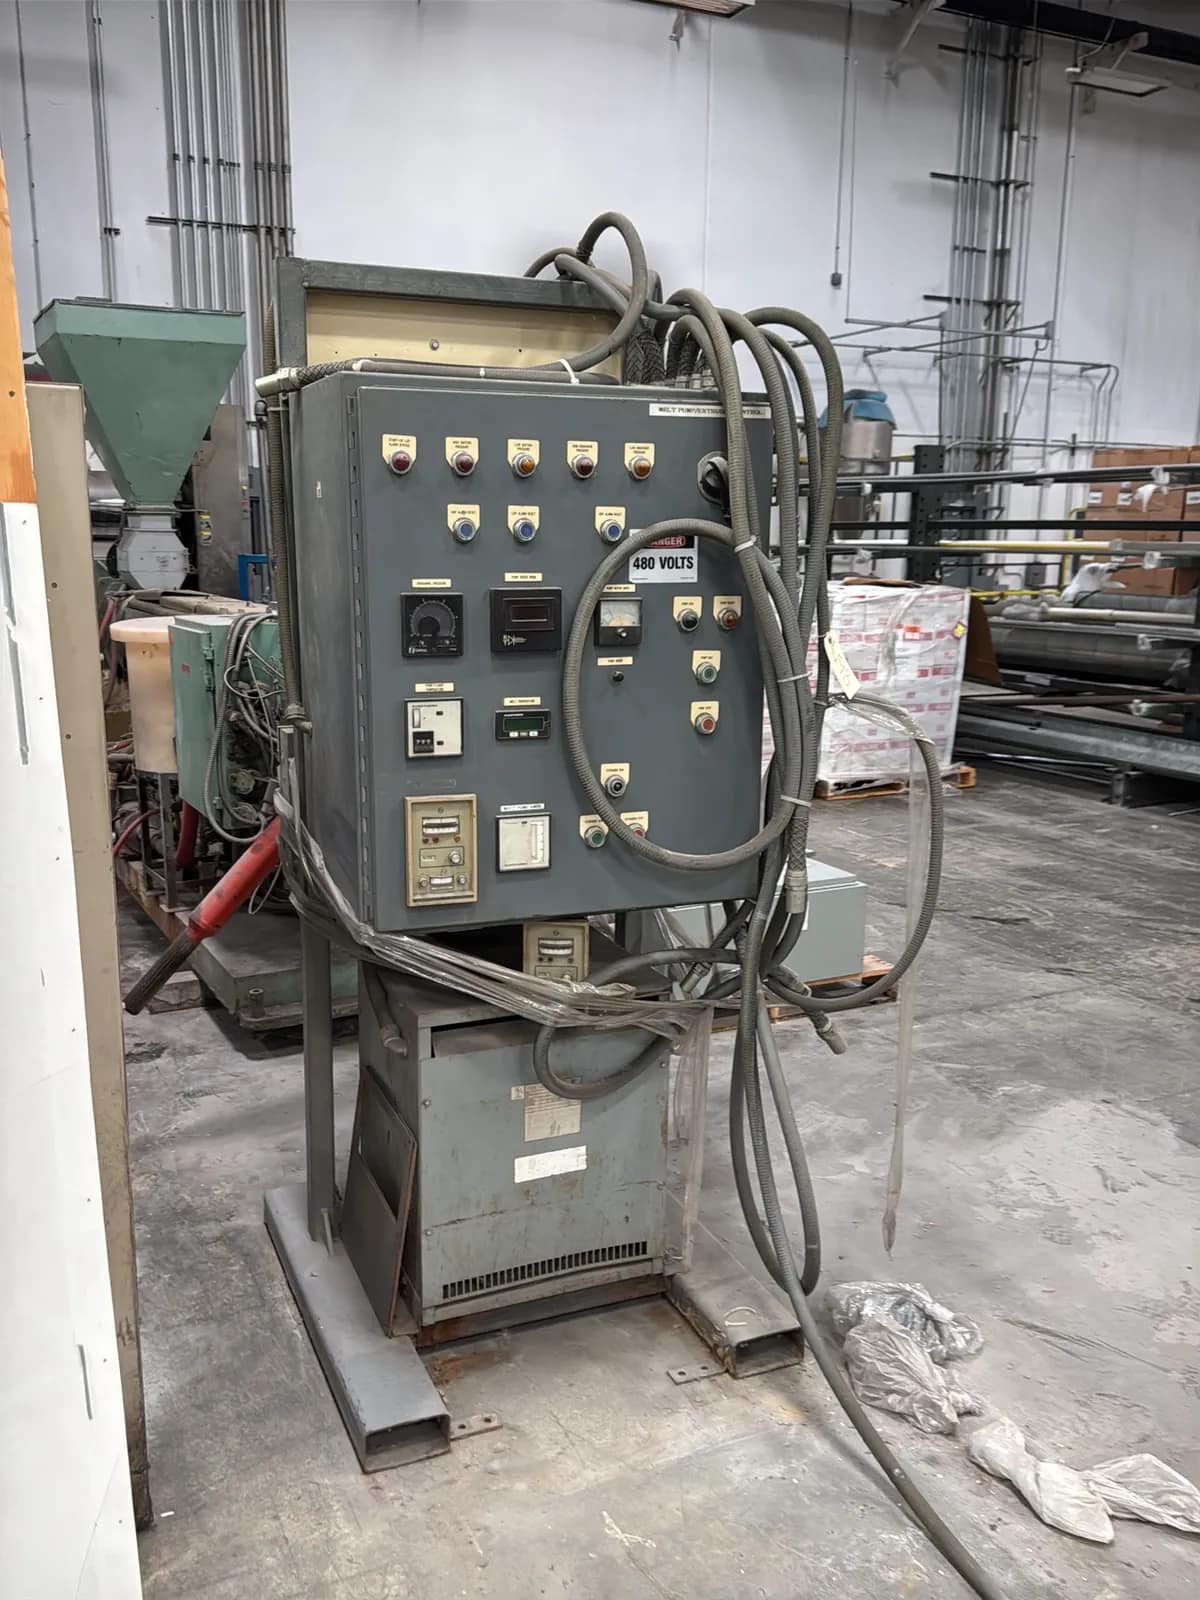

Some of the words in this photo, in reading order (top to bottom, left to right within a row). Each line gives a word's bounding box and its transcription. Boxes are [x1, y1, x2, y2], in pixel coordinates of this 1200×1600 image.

[652, 536, 683, 546] ANGER
[633, 556, 655, 570] 480
[659, 556, 694, 570] VOLTS
